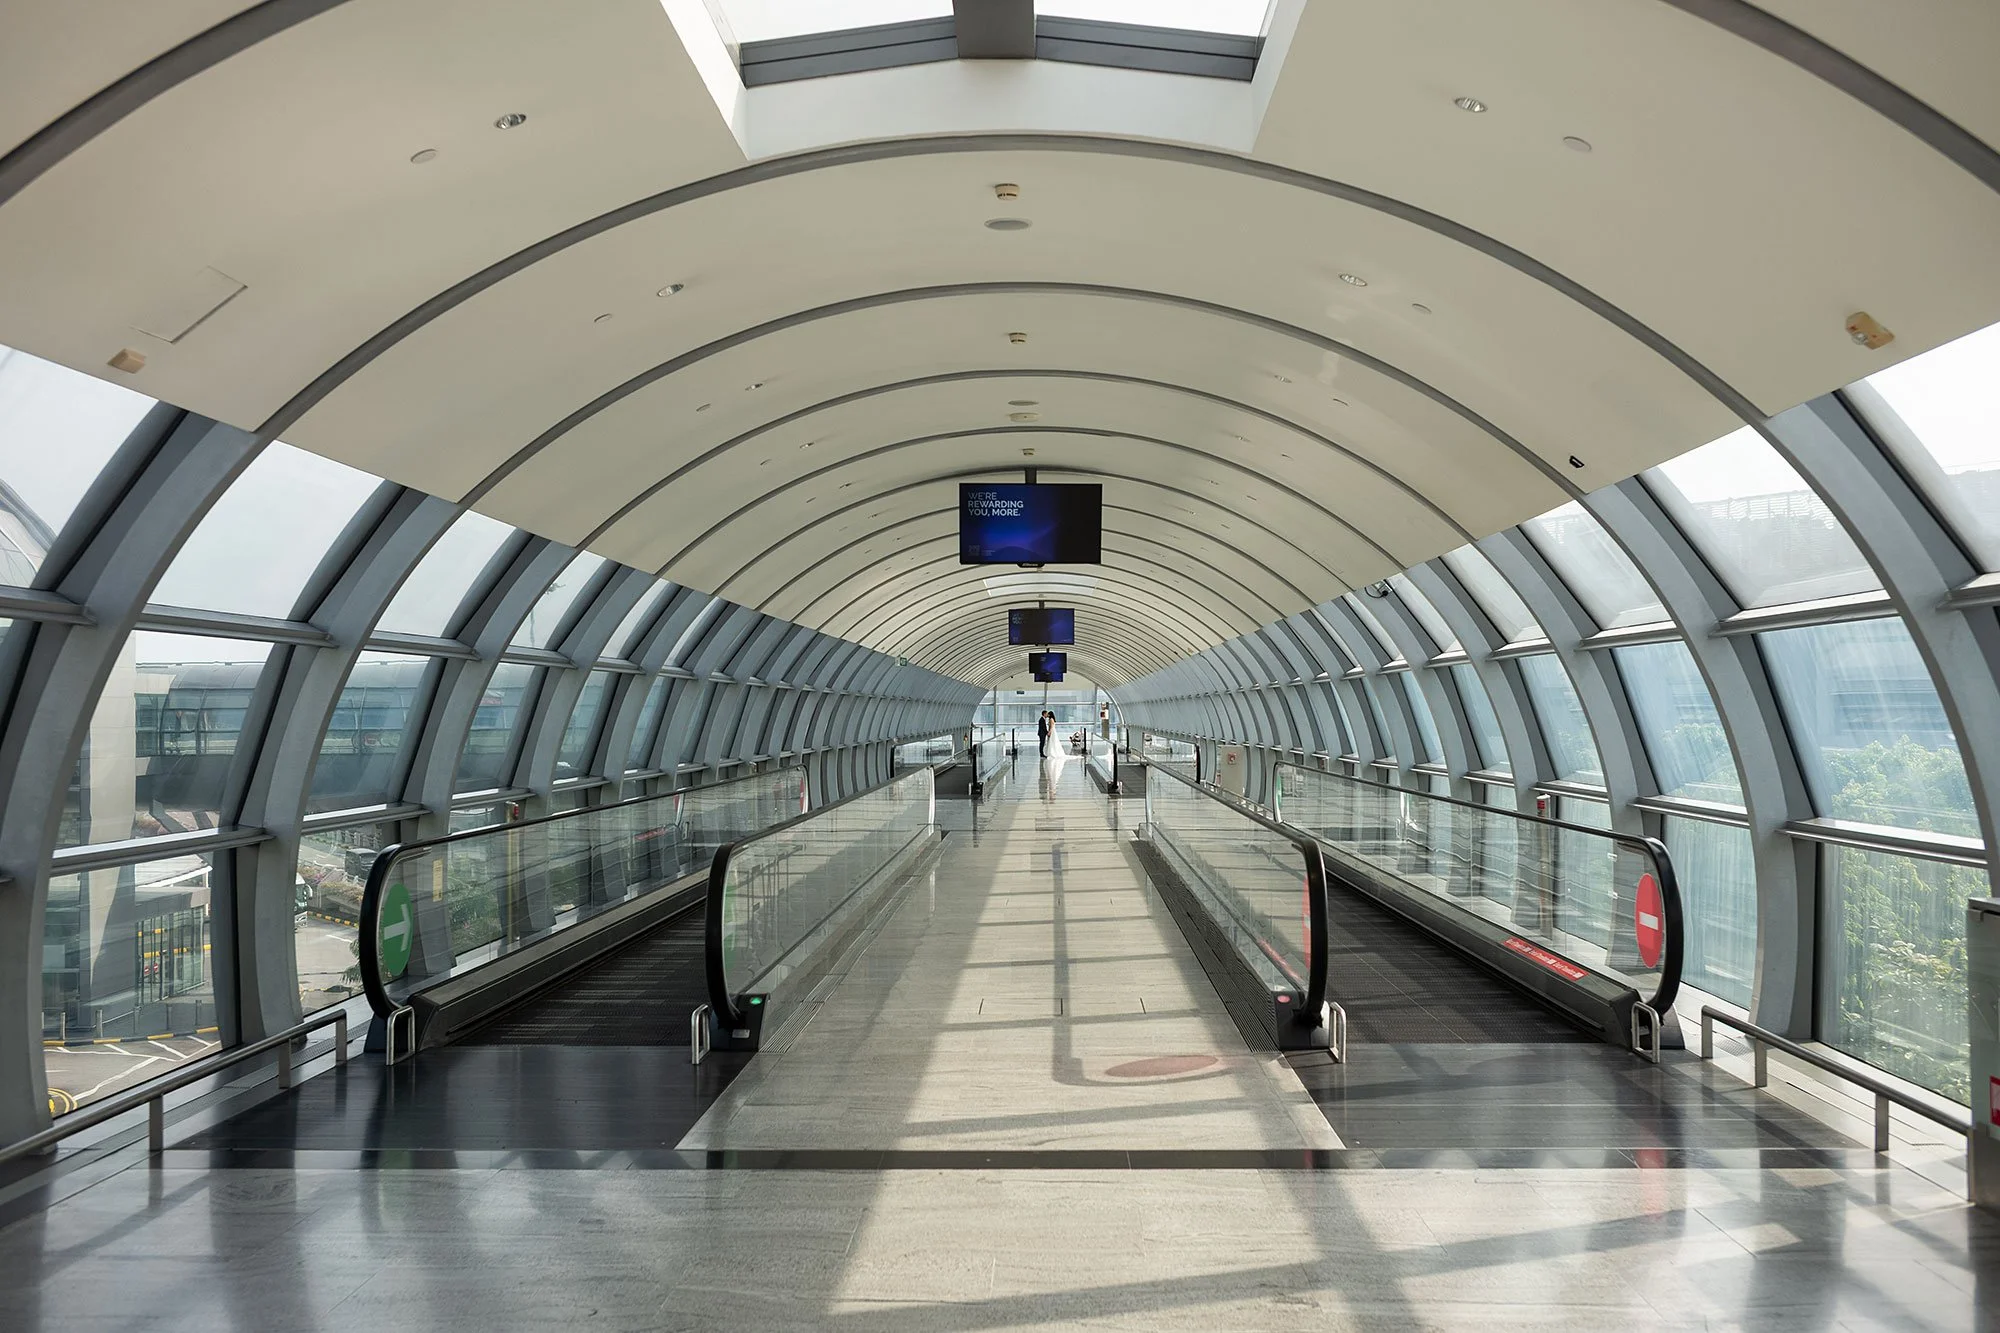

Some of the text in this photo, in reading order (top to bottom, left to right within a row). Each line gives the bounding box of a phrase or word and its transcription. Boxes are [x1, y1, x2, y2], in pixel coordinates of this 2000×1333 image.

[968, 492, 998, 500] WE'RE
[967, 500, 1024, 508] REWARDING
[968, 508, 1021, 517] YOU, MORE.
